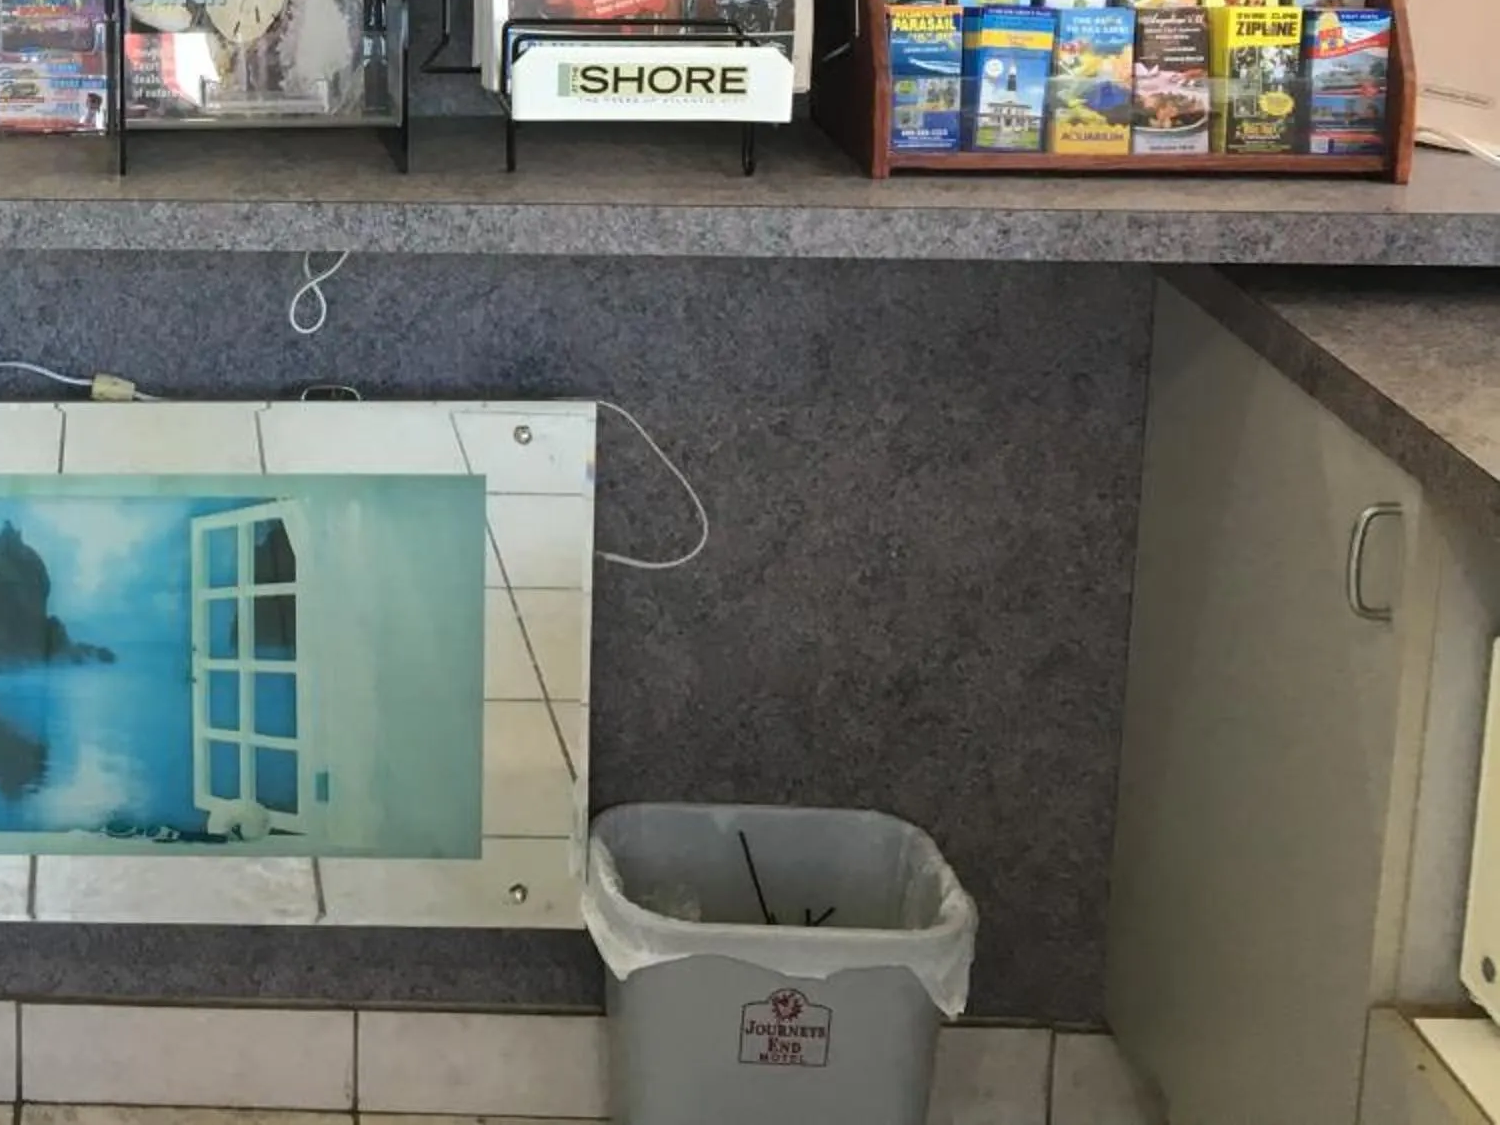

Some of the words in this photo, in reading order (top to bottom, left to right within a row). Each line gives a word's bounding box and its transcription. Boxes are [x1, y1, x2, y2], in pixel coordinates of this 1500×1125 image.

[1236, 22, 1297, 36] ZIPLINE
[579, 65, 747, 95] SHORE
[746, 1020, 825, 1038] JOURNEYS
[768, 1037, 801, 1053] END
